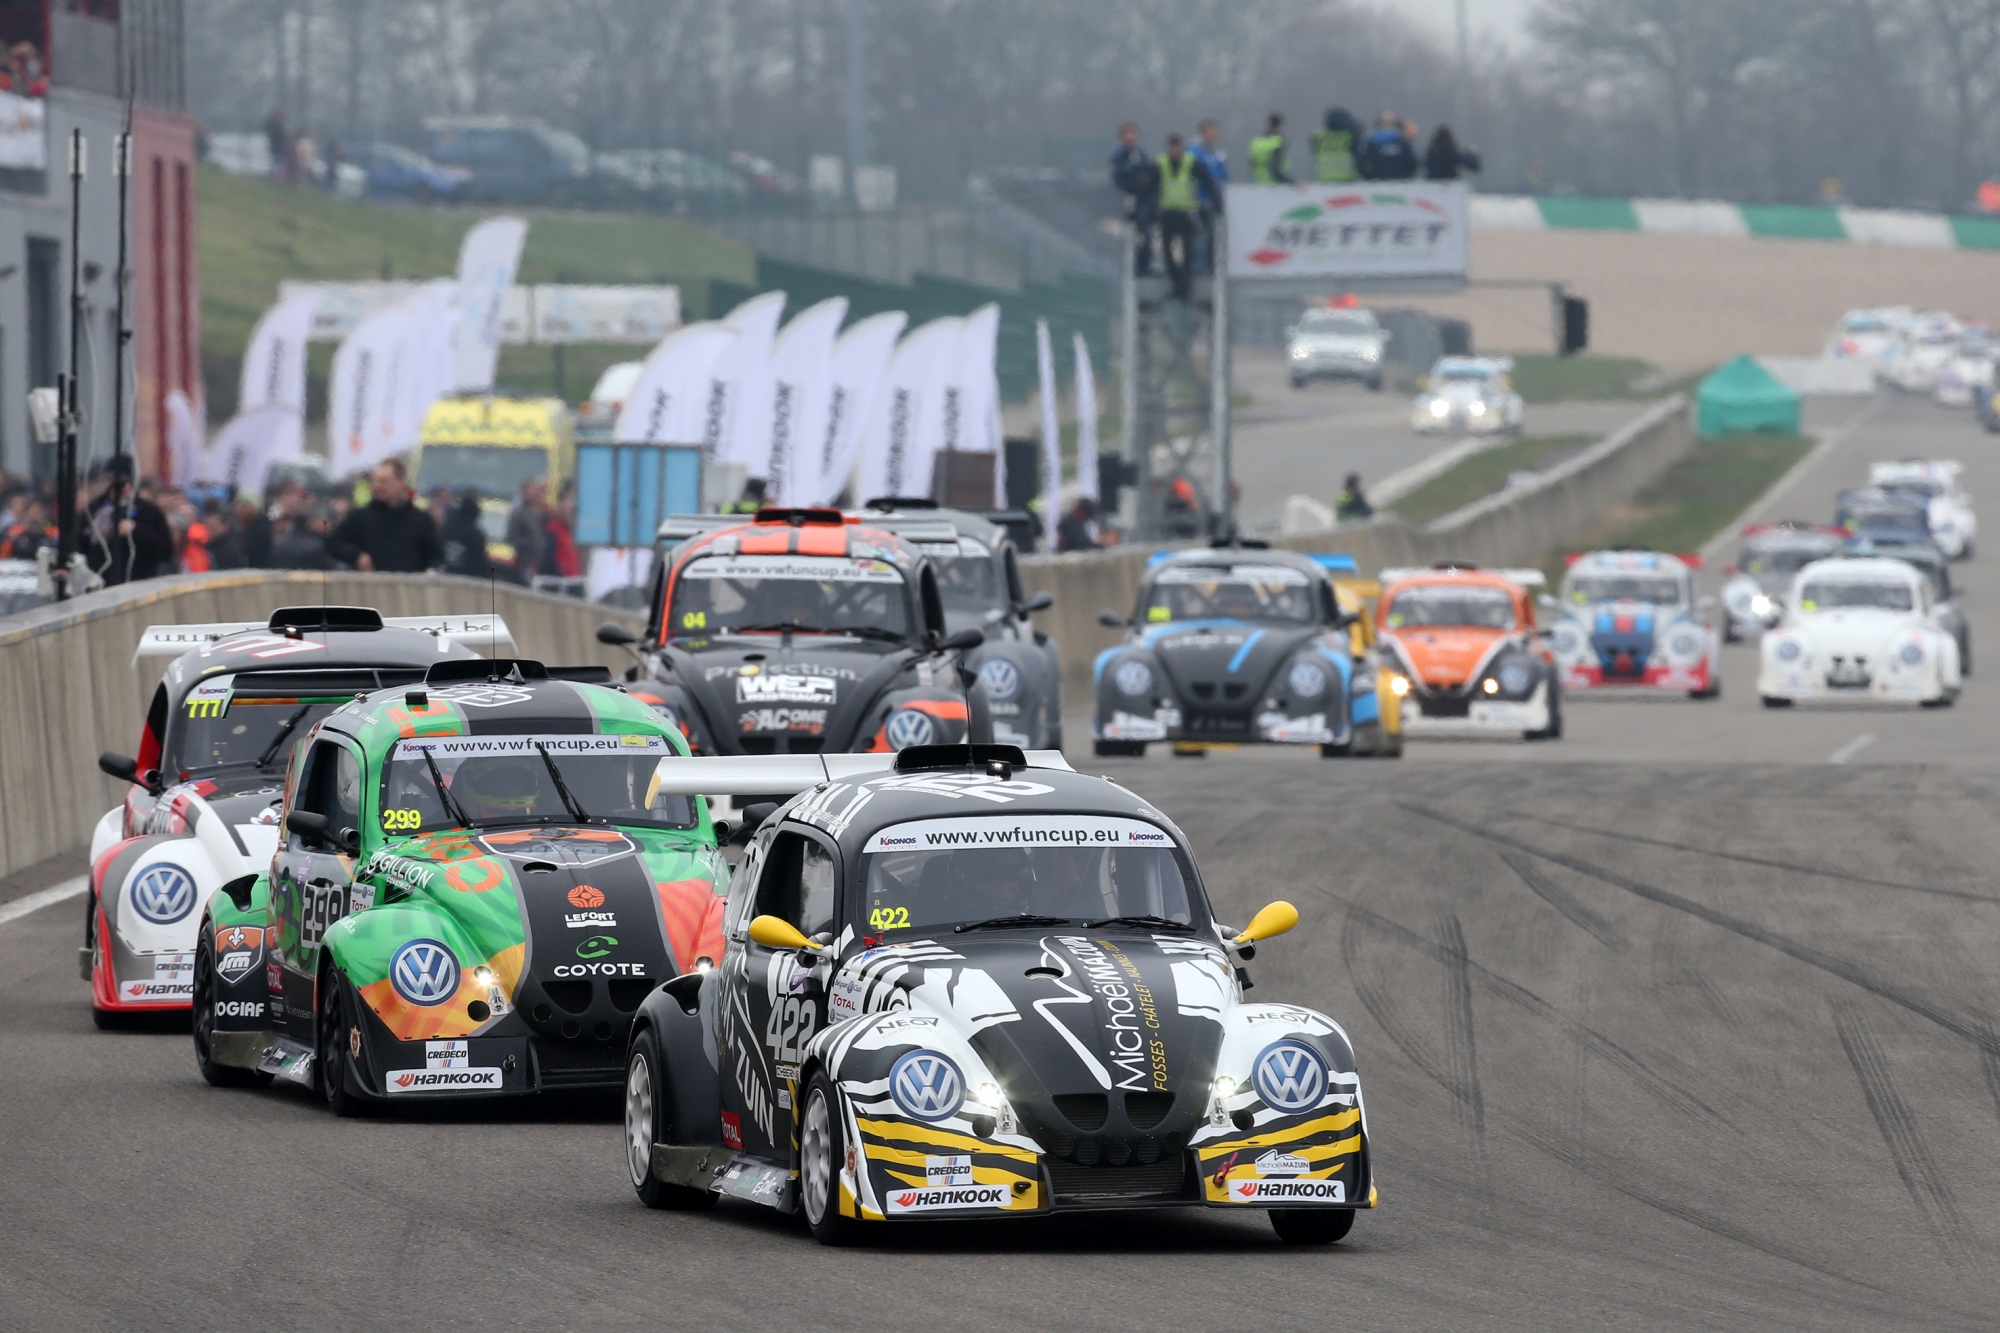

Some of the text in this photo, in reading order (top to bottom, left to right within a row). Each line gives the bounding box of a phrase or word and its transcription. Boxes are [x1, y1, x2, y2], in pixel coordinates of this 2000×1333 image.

[1266, 221, 1451, 247] METTET
[724, 564, 861, 577] www.vwfuncup.eu
[683, 612, 706, 629] 04
[186, 700, 222, 718] 777
[443, 737, 618, 751] www.vwfuncup.eu
[383, 809, 421, 829] 299
[880, 835, 917, 846] KRONOS
[925, 826, 1120, 846] www.vwfuncup.eu
[1128, 831, 1165, 841] KRONOS
[564, 912, 615, 922] LEFORT
[869, 907, 911, 930] 422
[156, 963, 193, 971] CREDECO
[553, 963, 646, 977] COYOTE
[144, 983, 193, 995] HANK
[215, 1001, 265, 1017] OGIAF
[833, 993, 856, 1011] TOTAL
[766, 996, 817, 1063] 422
[427, 1050, 467, 1059] CREDECO
[1149, 1039, 1168, 1091] FOSSES
[721, 1117, 742, 1143] TOTAL
[927, 1165, 970, 1176] CREDECO
